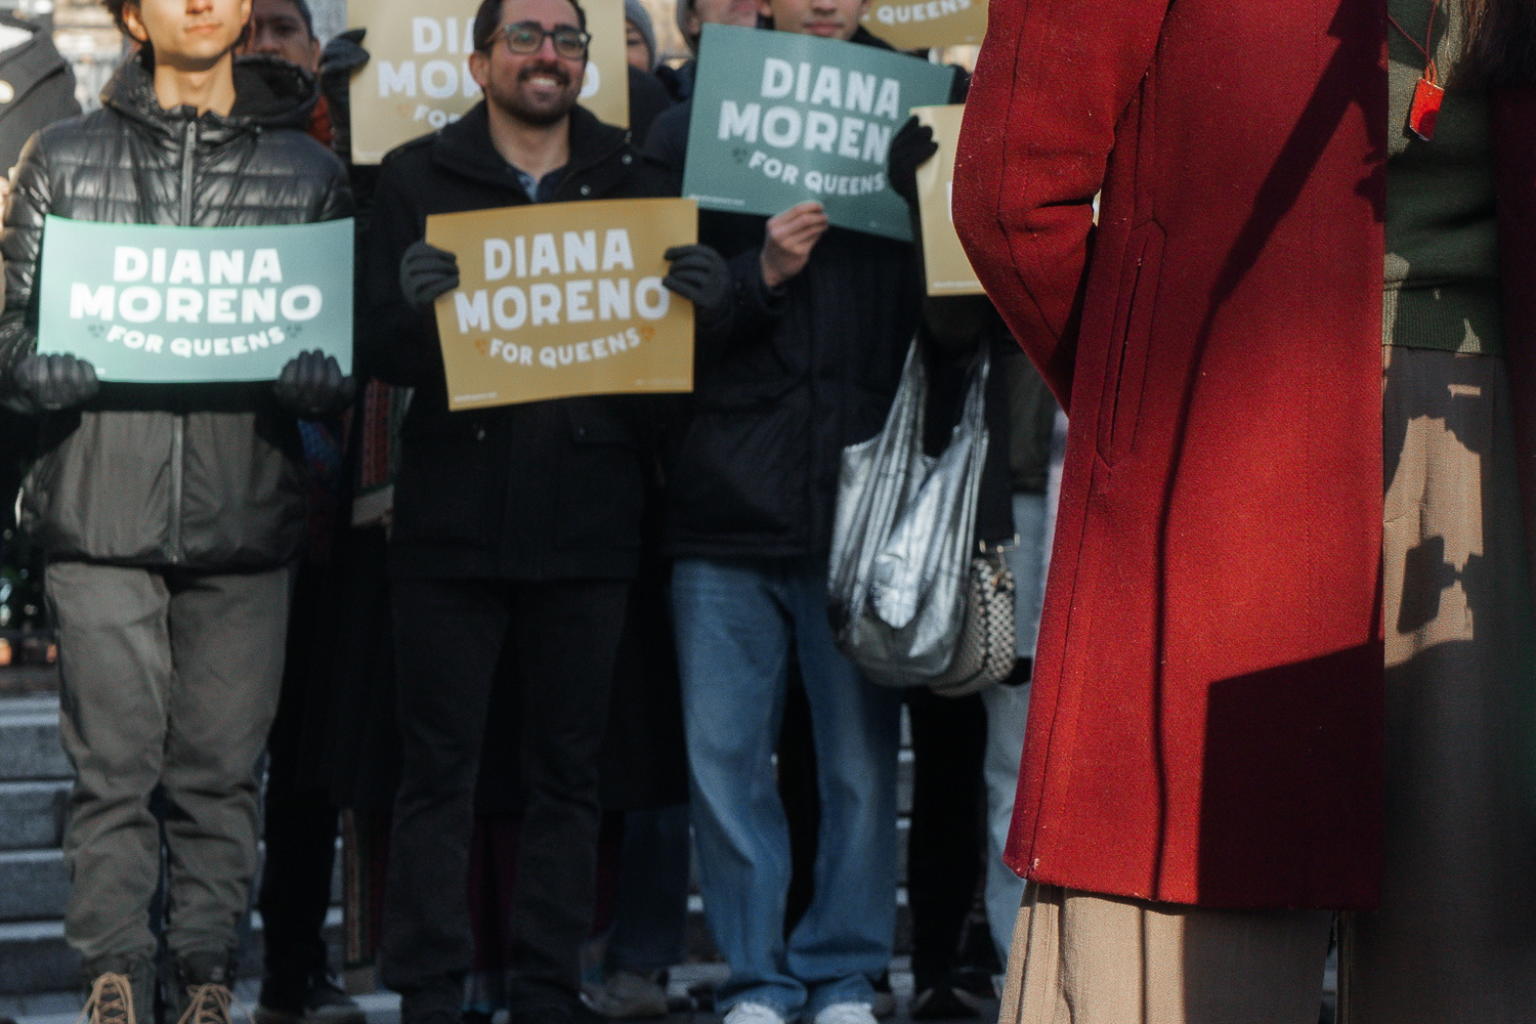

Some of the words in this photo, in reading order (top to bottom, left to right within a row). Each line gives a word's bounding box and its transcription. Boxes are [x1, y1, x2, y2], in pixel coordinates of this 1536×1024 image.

[761, 57, 900, 121] DIANA
[717, 100, 894, 166] MOREN
[748, 150, 800, 186] FOR
[804, 172, 886, 196] QUEENS
[113, 246, 283, 284] DIANA
[483, 228, 635, 281] DIANA
[69, 281, 324, 324] MORENO
[453, 276, 671, 334] MORENO
[106, 324, 165, 355] FOR
[169, 326, 286, 358] QUEENS
[489, 337, 534, 367] FOR
[538, 327, 642, 369] QUEENS
